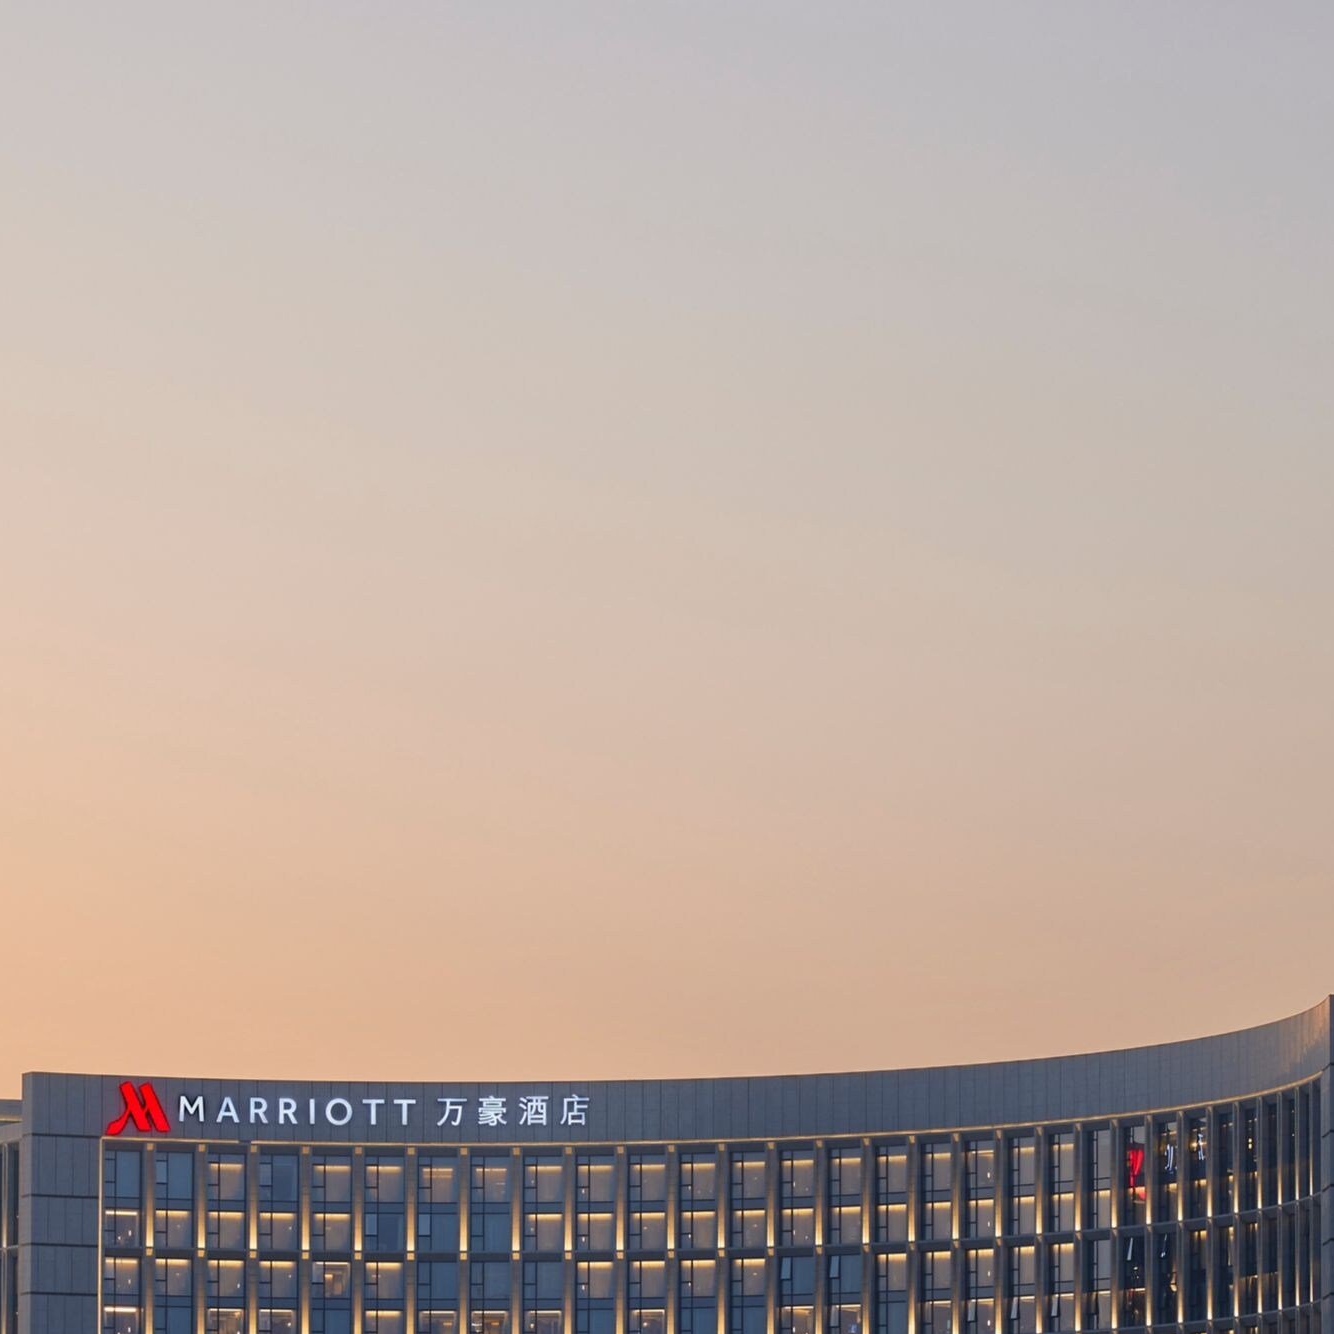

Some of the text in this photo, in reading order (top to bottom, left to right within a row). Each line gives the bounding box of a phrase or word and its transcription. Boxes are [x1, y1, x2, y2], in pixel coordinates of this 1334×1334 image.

[178, 1095, 417, 1126] MARRIOTT
[436, 1094, 590, 1127] 万豪酒店
